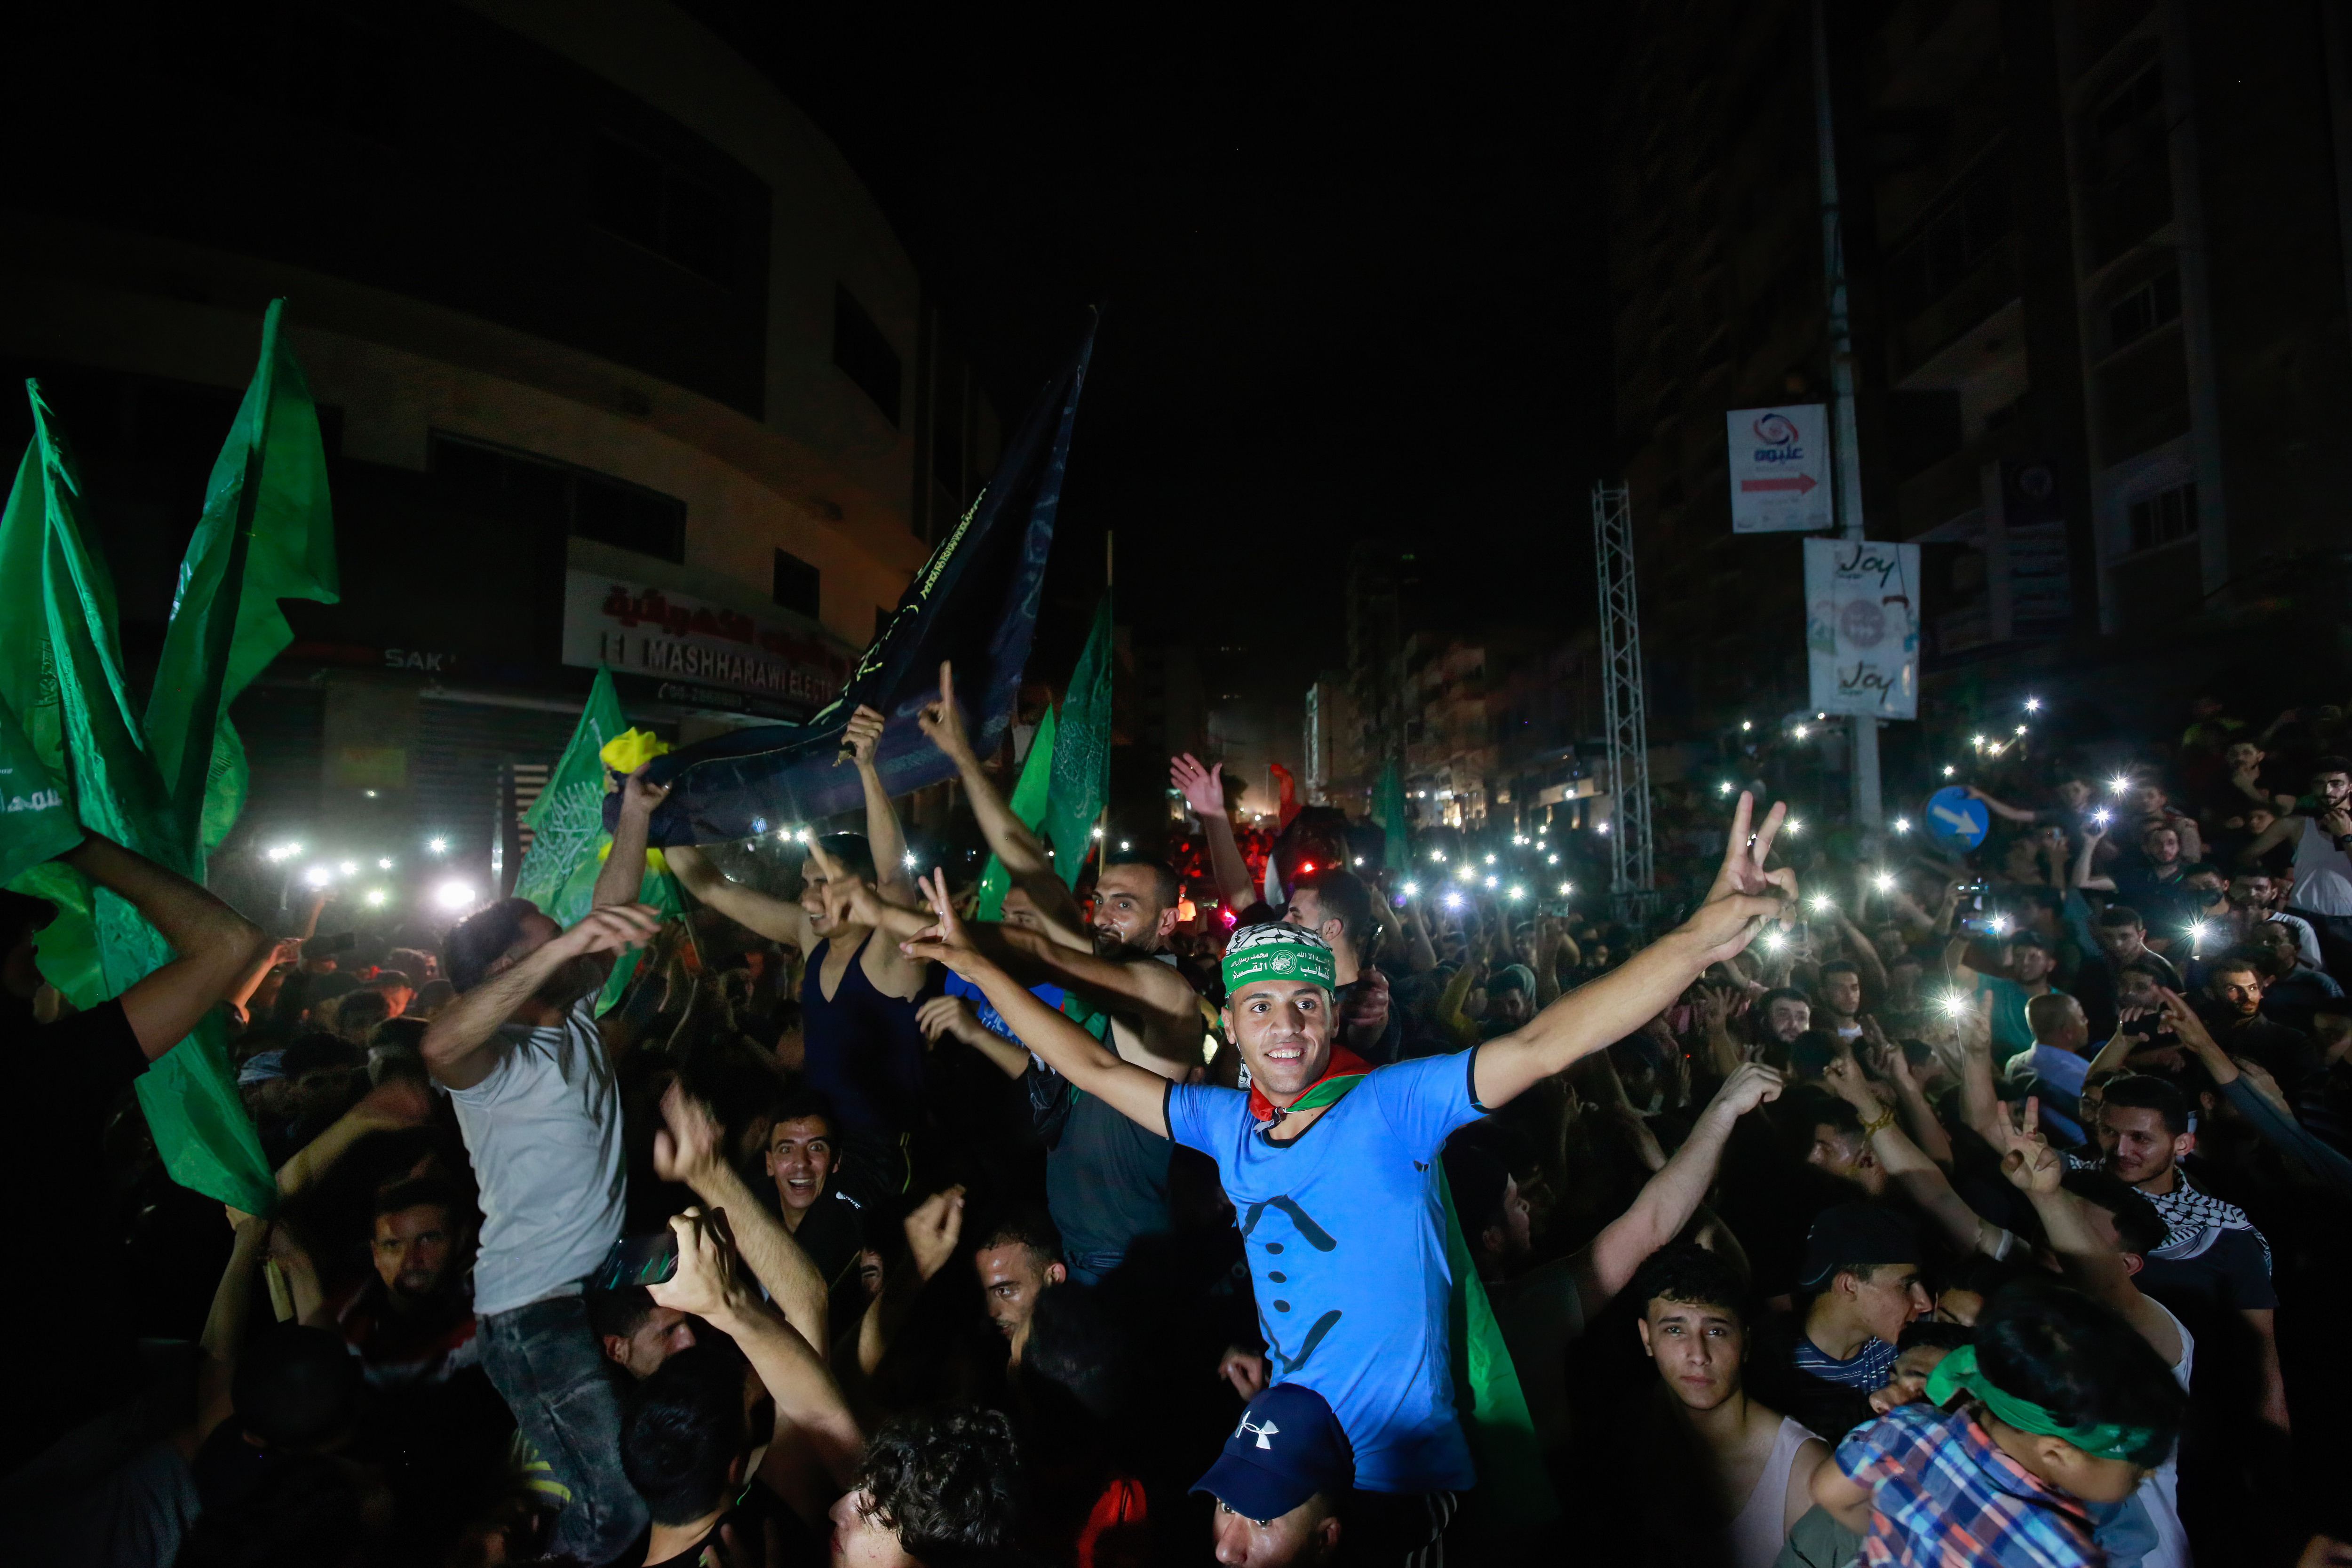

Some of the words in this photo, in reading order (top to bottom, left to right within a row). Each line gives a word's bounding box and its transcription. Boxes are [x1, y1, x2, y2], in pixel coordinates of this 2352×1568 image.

[1840, 544, 1895, 589] Joy
[1838, 660, 1895, 705] Joy
[1232, 962, 1268, 983] القسام
[1300, 963, 1330, 980] كتائب
